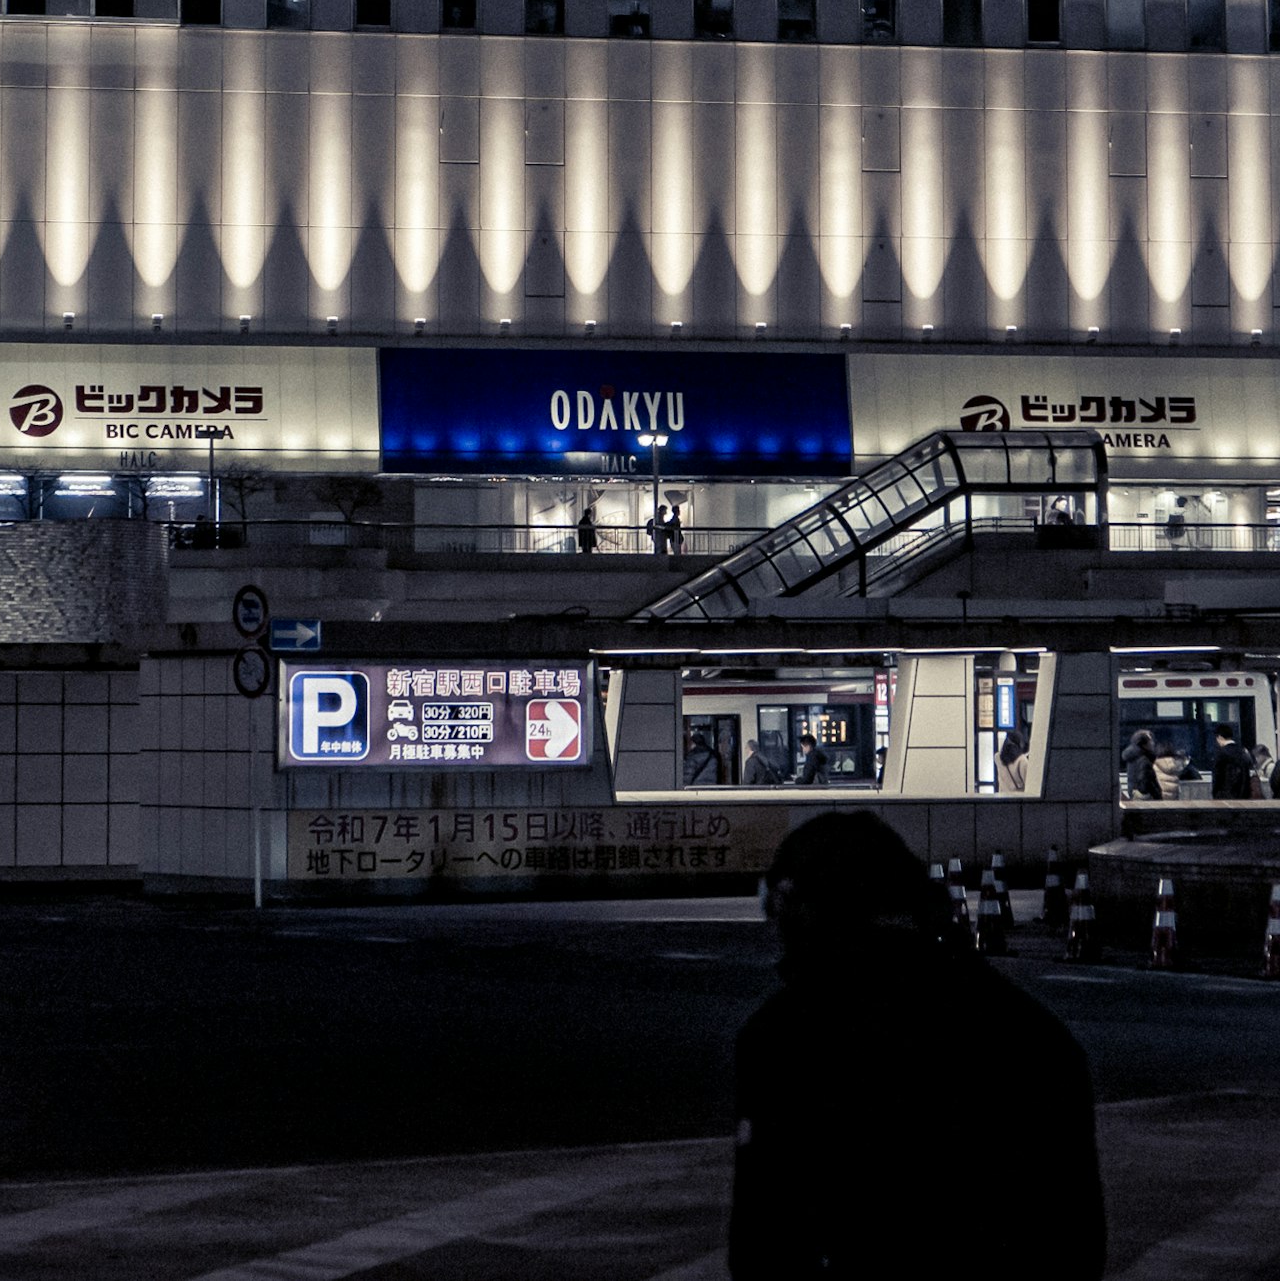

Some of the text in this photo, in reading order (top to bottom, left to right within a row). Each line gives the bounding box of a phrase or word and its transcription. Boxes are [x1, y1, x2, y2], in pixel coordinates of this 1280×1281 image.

[75, 385, 264, 414] ビックカメラ
[551, 388, 684, 432] ODAKYU
[1021, 395, 1197, 424] ビックカメラ
[106, 424, 139, 439] BIC
[120, 451, 157, 468] HALC
[600, 455, 637, 474] HALC
[386, 669, 581, 697] 新宿駅西口駐車場
[302, 678, 358, 754] P
[424, 704, 492, 720] 30分/320円
[424, 724, 492, 740] 30分/210円
[529, 723, 553, 737] 24h
[320, 740, 362, 754] 年中無休
[388, 744, 484, 760] 月極駐車募集中
